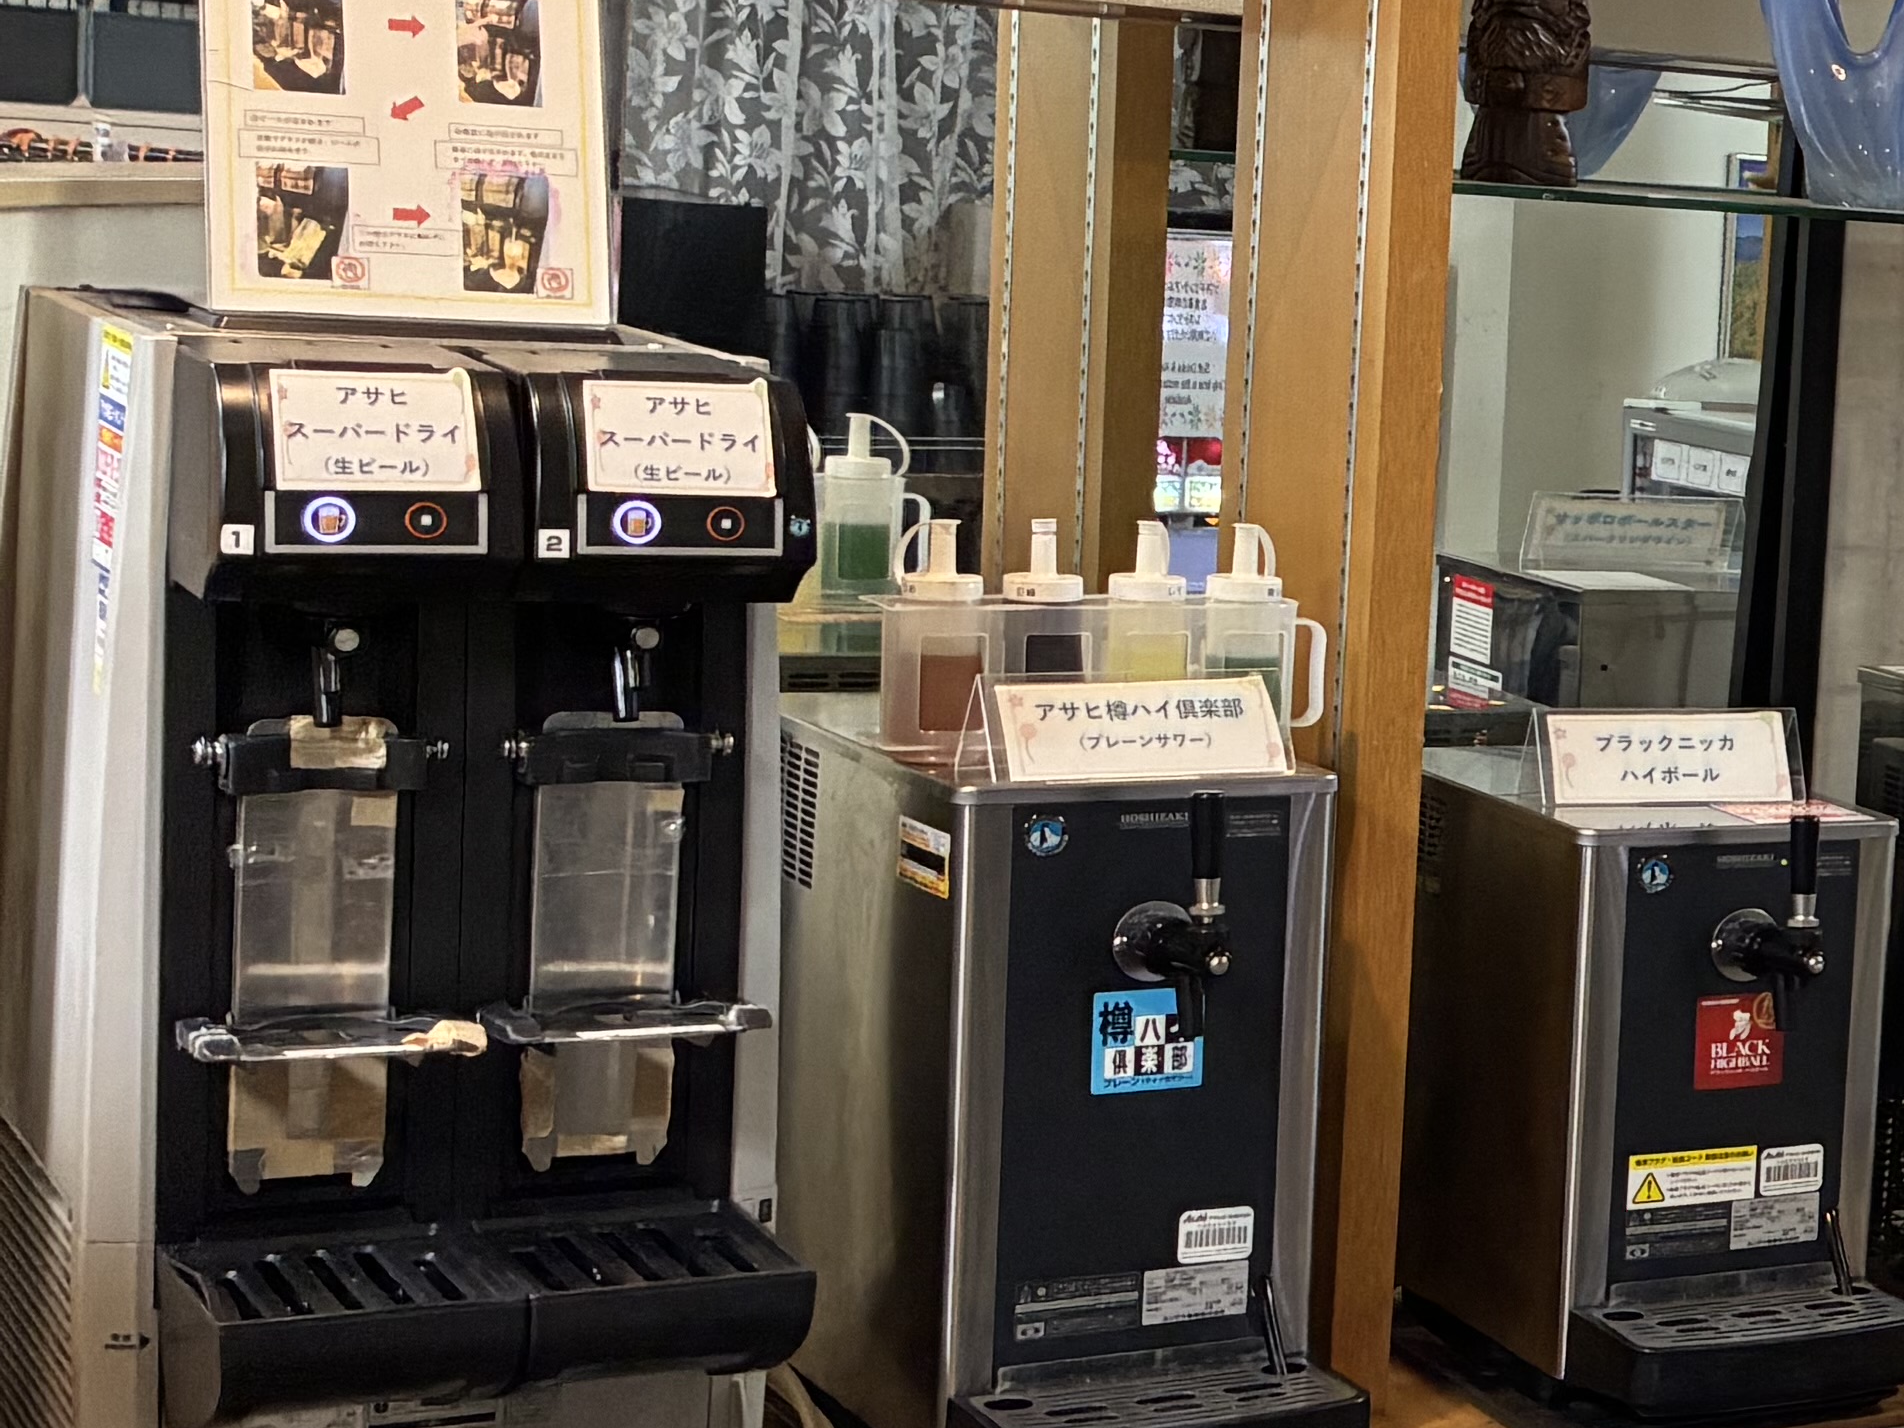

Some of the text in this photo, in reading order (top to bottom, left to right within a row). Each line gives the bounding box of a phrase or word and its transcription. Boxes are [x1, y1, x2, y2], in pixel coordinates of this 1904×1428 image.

[336, 387, 408, 408] アサヒ
[646, 397, 712, 416] アサヒ
[286, 420, 461, 446] スーパードライ
[598, 429, 760, 454] スーパードライ
[230, 530, 243, 549] 1
[546, 535, 564, 554] 2
[1035, 697, 1244, 722] アサヒ樽ハイ倶楽部
[1595, 734, 1736, 753] ブラックニッカ
[1619, 767, 1721, 785] ハイボール
[1710, 1038, 1771, 1059] BLACK
[1710, 1054, 1771, 1070] HIGHBALL
